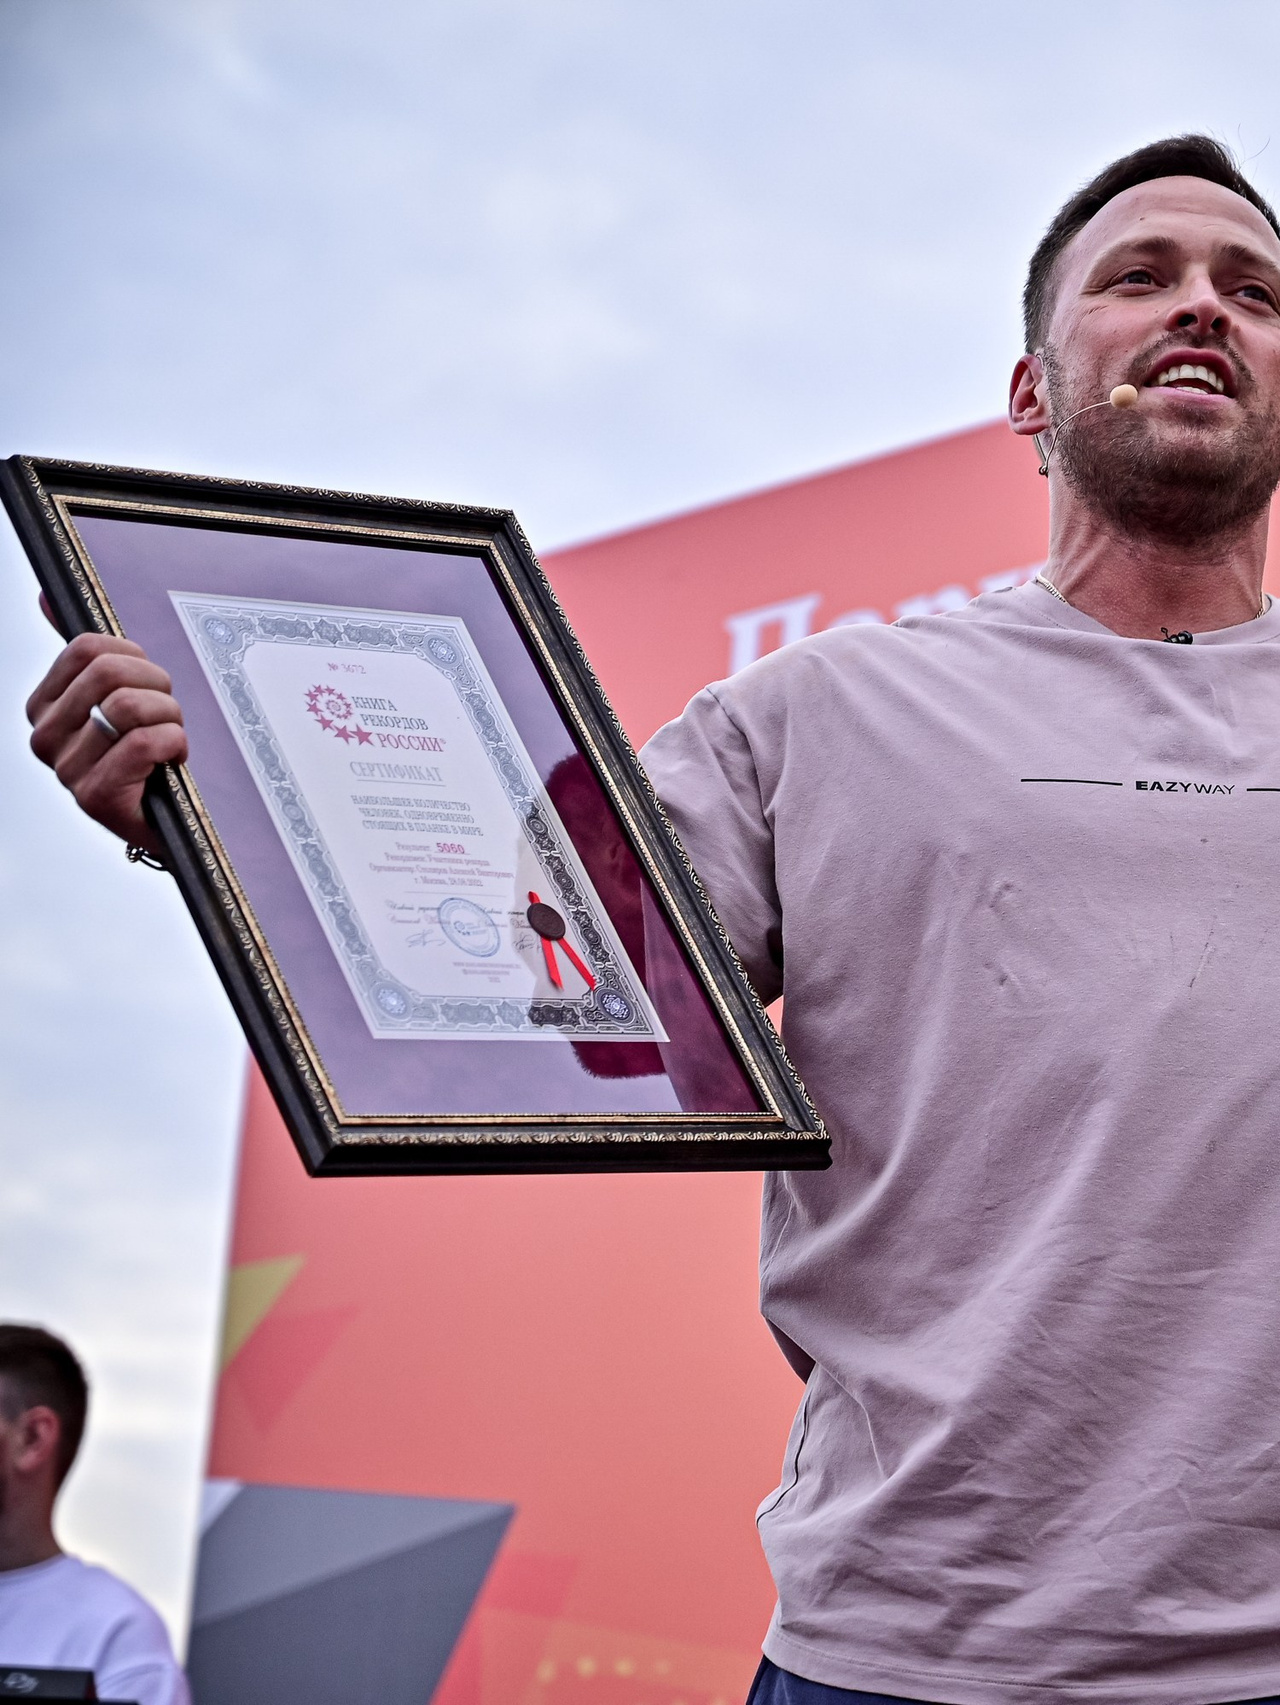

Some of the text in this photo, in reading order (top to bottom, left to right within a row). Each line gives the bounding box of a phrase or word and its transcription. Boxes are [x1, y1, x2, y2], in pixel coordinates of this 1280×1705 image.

[340, 663, 367, 675] 3672
[351, 696, 398, 712] КНИГА
[360, 713, 428, 731] РЕКОРДОВ
[349, 761, 443, 782] СЕРТИФИКАТ
[414, 799, 471, 811] КОЛИЧЕСТВО
[436, 842, 465, 854] 5060
